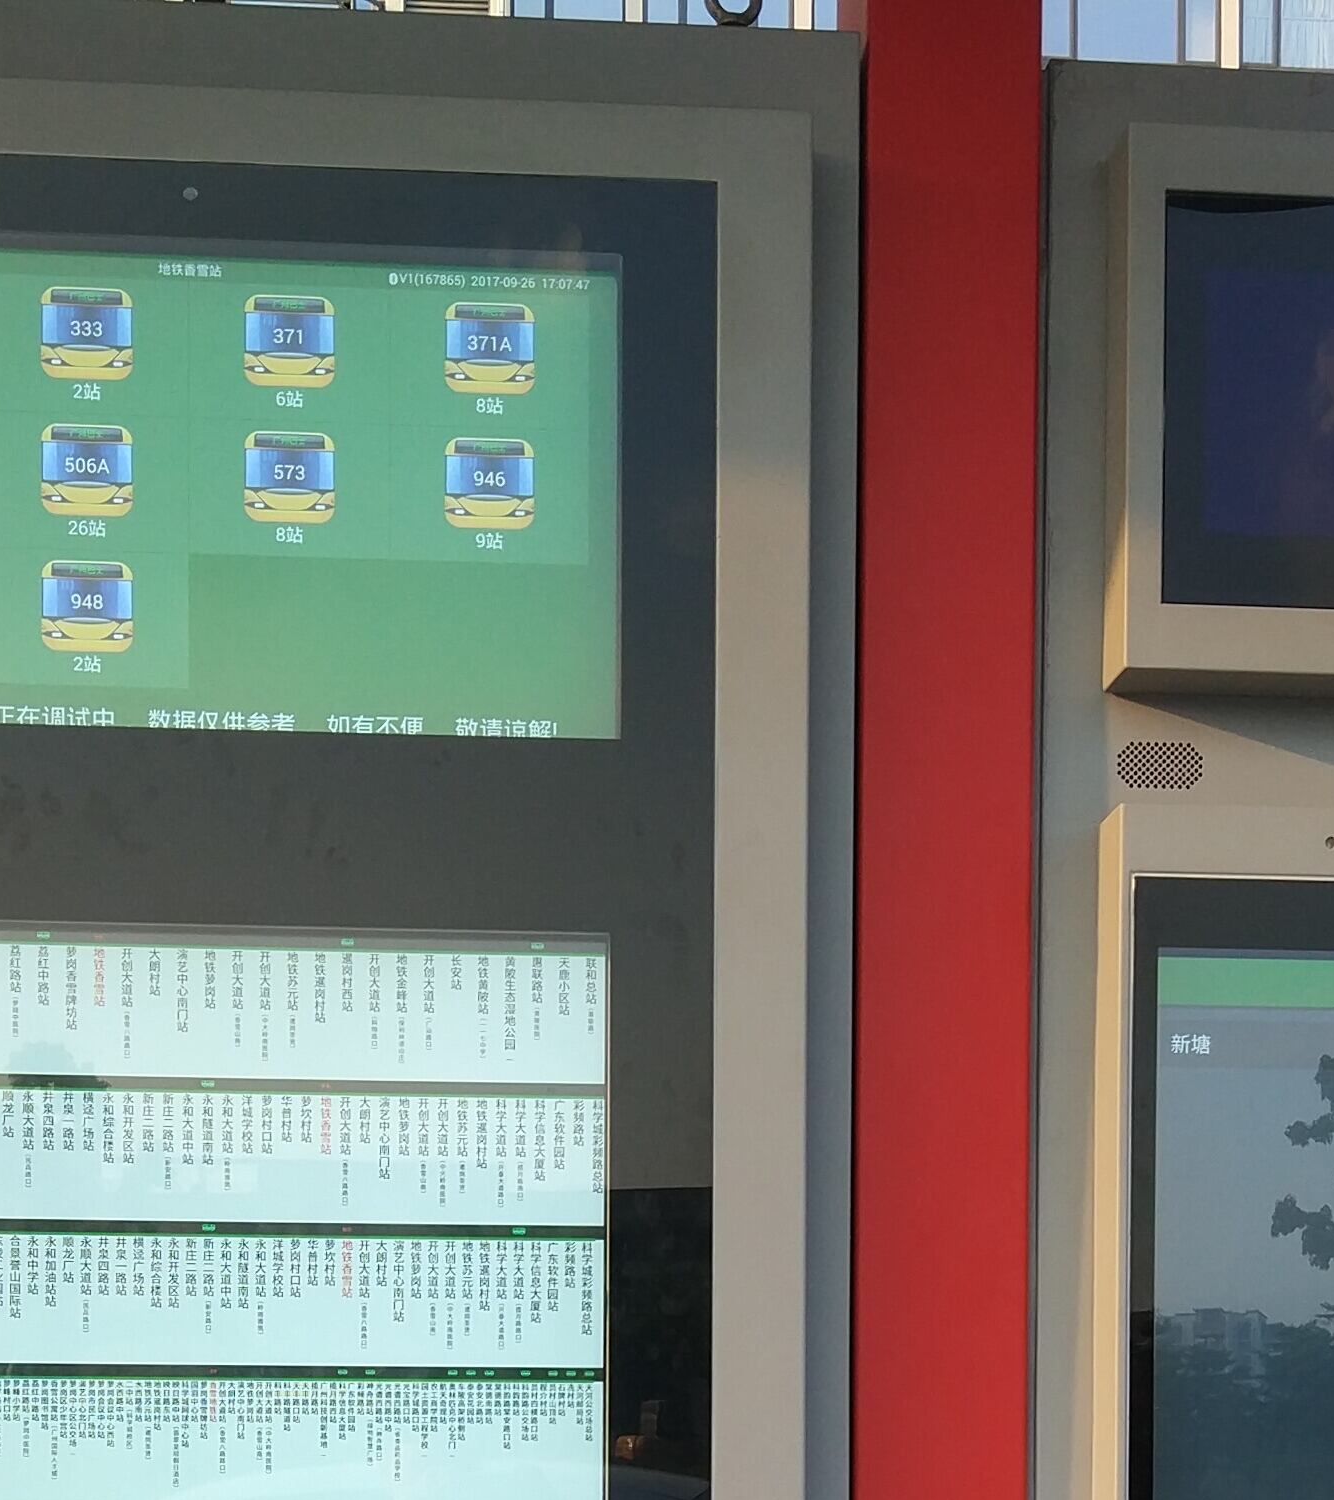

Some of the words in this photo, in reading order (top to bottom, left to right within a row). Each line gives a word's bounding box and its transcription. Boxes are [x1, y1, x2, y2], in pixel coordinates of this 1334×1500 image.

[158, 263, 222, 277] 地铁香雪站
[471, 276, 535, 289] 2017-09-26
[542, 278, 590, 290] 17:07:47
[70, 321, 103, 336] 333
[273, 329, 303, 345] 371
[468, 335, 512, 352] 371A
[73, 383, 101, 400] 2站
[276, 391, 303, 408] 6站
[476, 398, 503, 415] 8站
[64, 458, 110, 474] 506A
[274, 465, 305, 480] 573
[473, 471, 506, 487] 946
[68, 520, 106, 538] 26站
[275, 527, 303, 544] 8站
[475, 532, 503, 550] 9站
[71, 594, 103, 609] 948
[73, 656, 101, 673] 2站
[1171, 1034, 1211, 1054] 新塘
